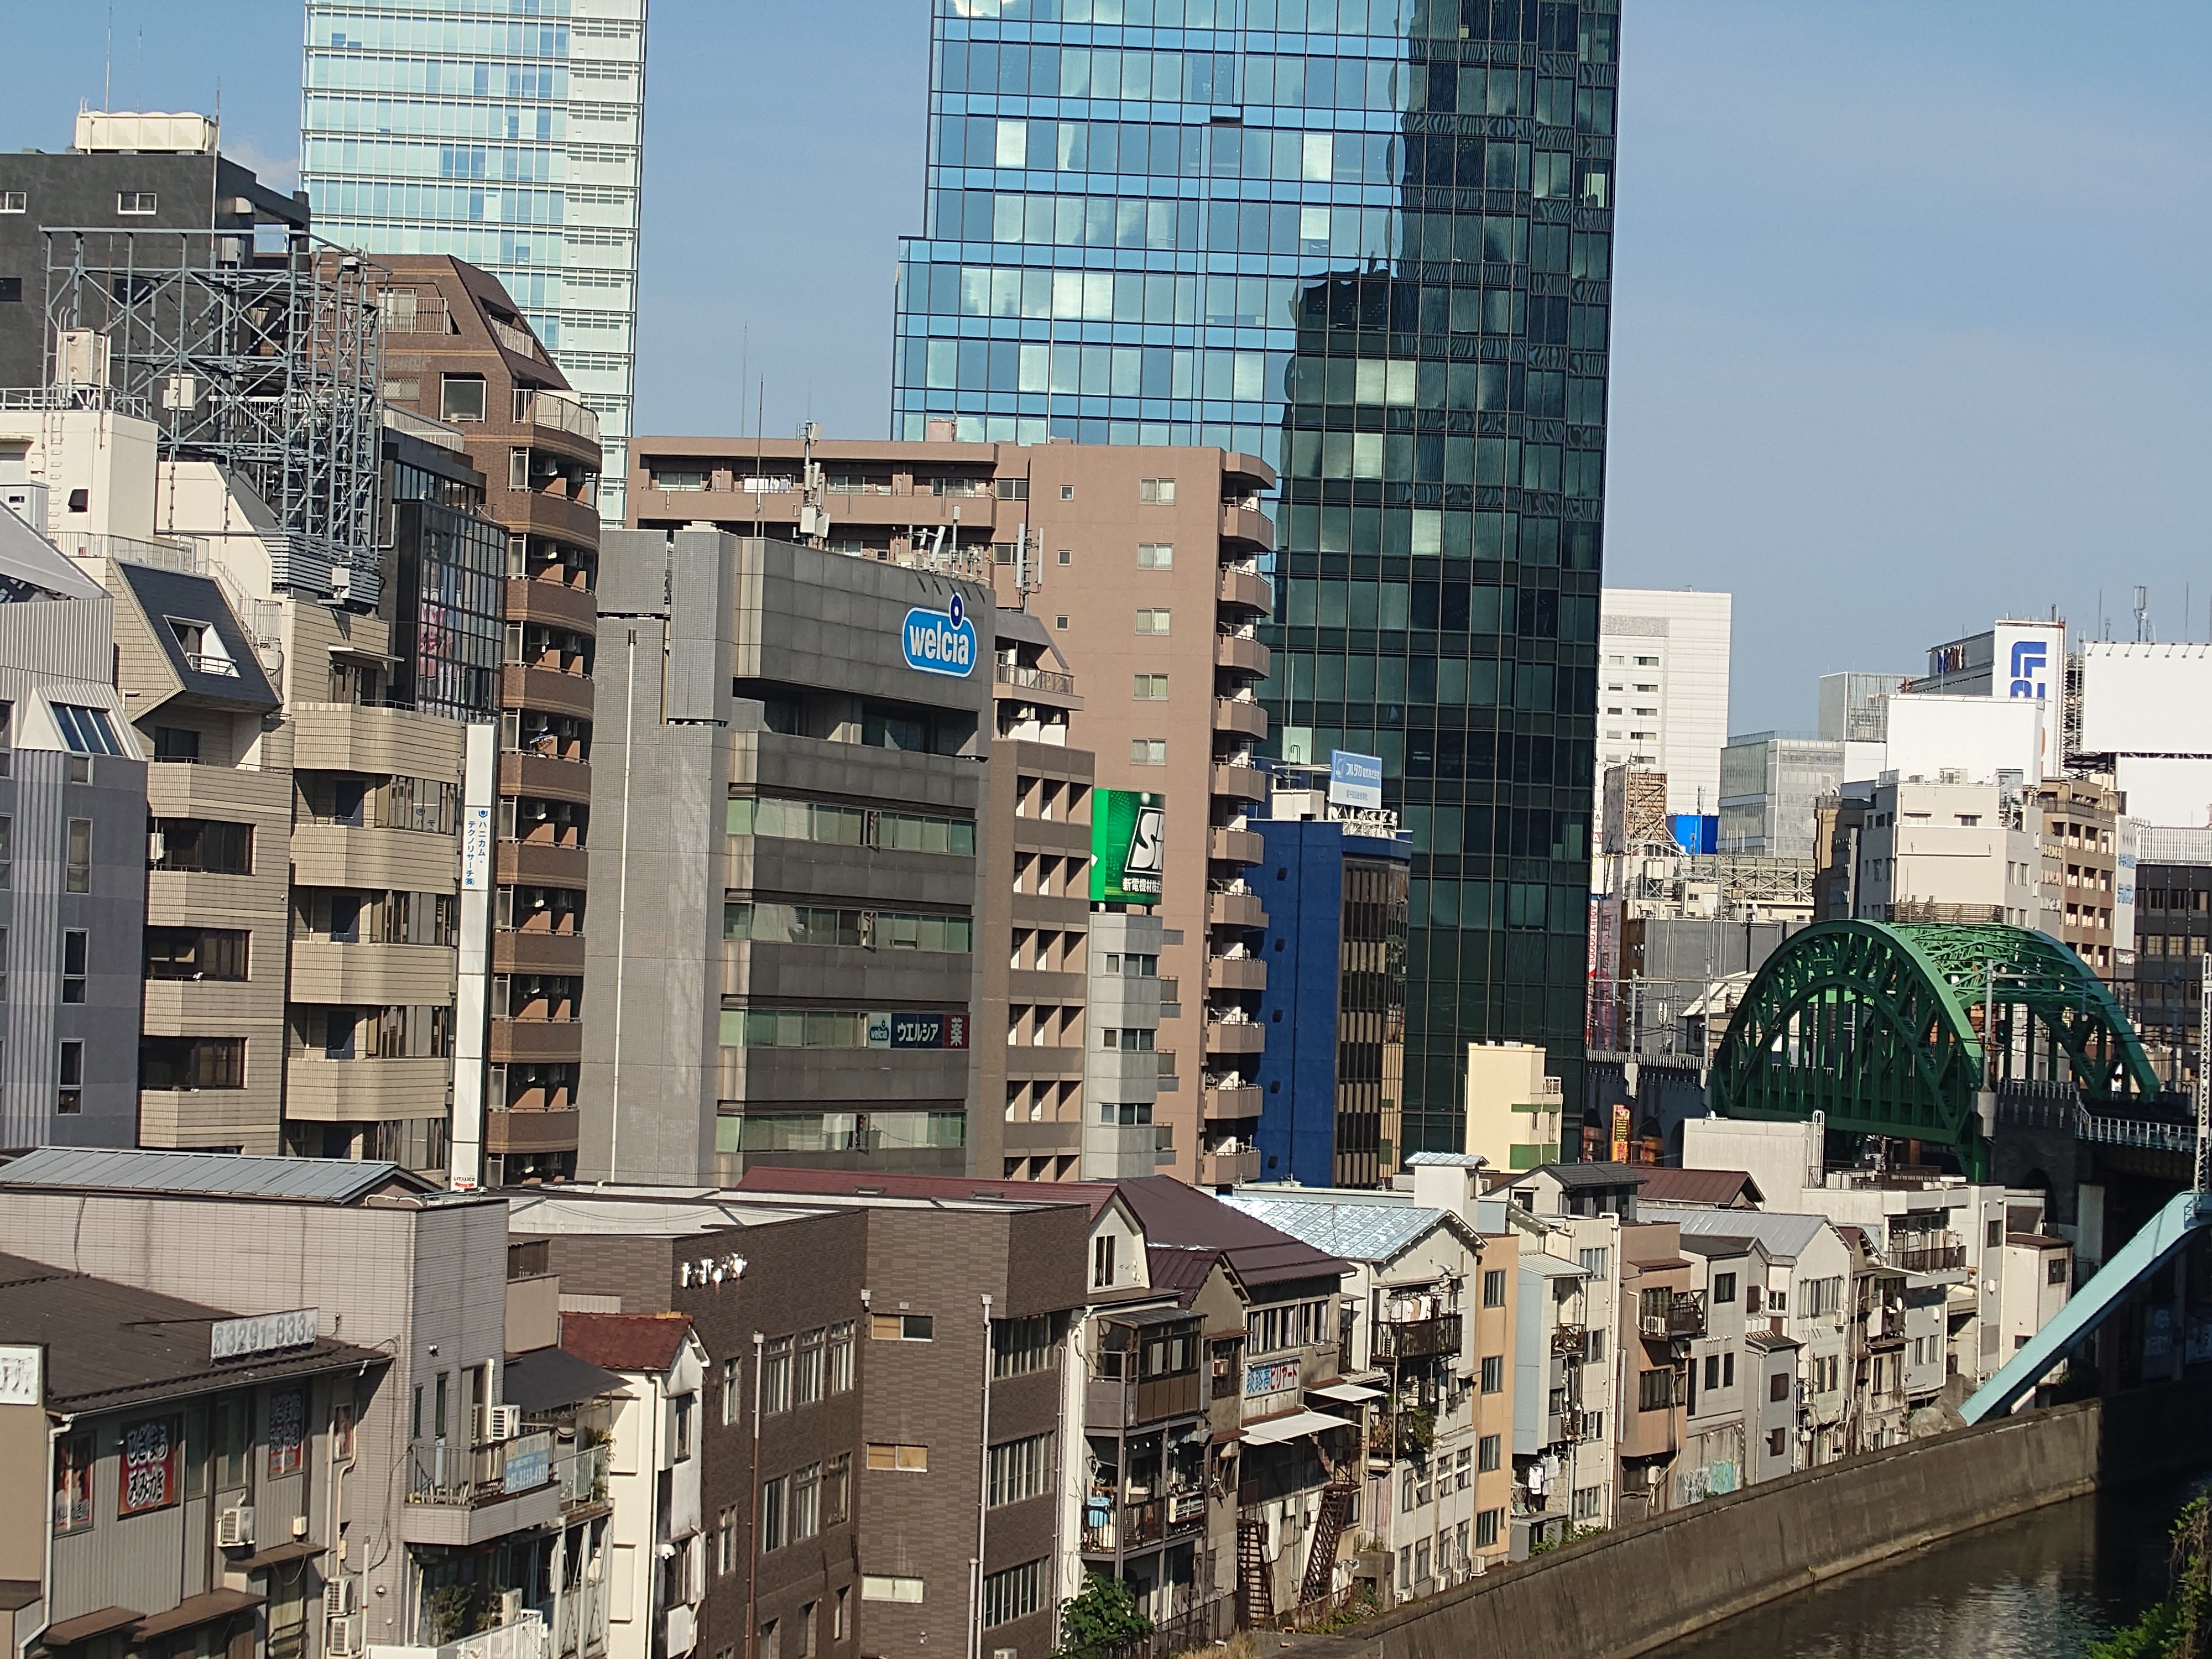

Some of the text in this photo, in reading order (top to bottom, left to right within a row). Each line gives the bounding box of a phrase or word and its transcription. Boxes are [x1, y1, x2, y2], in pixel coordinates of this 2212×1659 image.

[909, 620, 969, 665] welcia
[870, 1026, 888, 1040] welcia
[898, 1022, 939, 1042] ウエルシア
[950, 1016, 963, 1047] 薬
